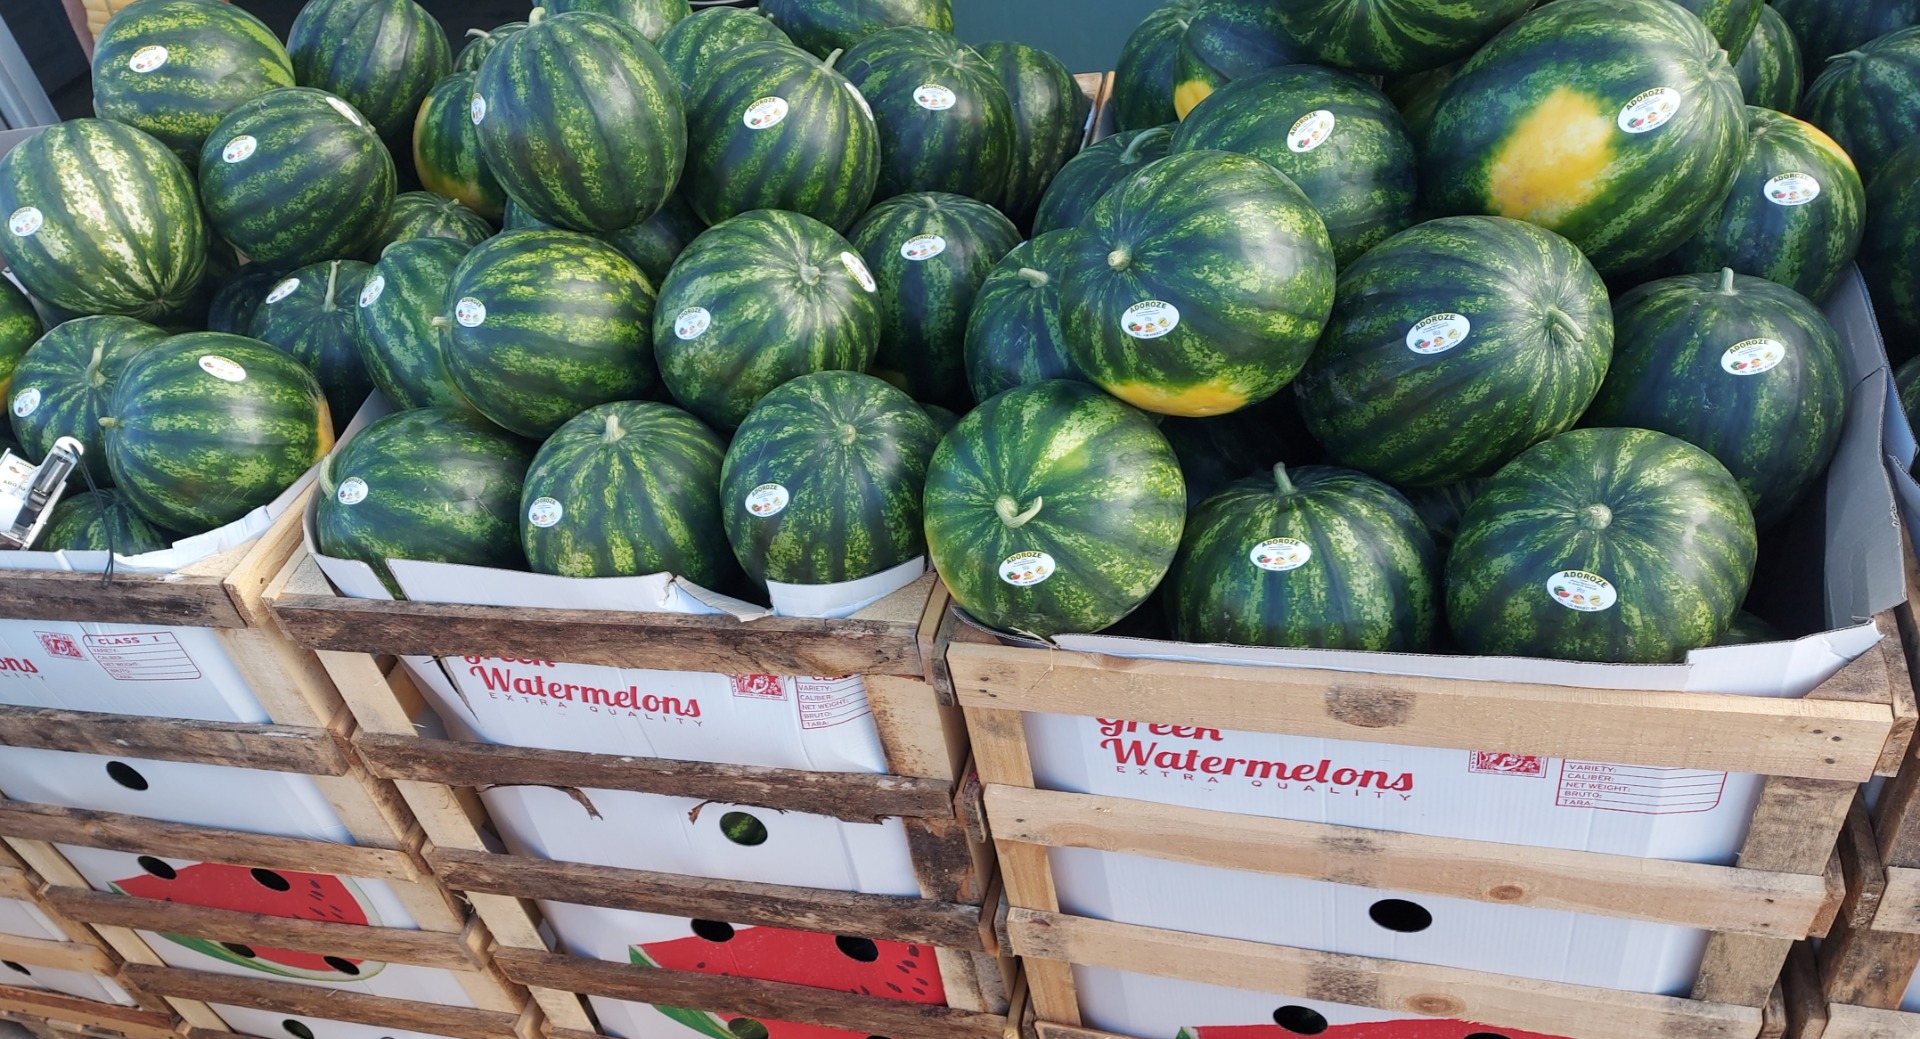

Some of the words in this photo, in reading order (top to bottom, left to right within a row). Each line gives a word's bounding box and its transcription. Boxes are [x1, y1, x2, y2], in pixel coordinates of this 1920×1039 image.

[748, 97, 776, 113] ADOROZE
[1626, 88, 1665, 111] ADOROZE
[1289, 112, 1318, 136] ADOROZE
[679, 307, 702, 321] ADOROZE
[1130, 301, 1167, 314] ADOROZE
[1415, 314, 1456, 331] ADOROZE
[1729, 339, 1769, 354] ADOROZE
[751, 484, 779, 498] ADOROZE
[1261, 538, 1301, 548] ADOROZE
[1006, 551, 1042, 564] ADOROZE
[1563, 571, 1608, 589] ADOROZE
[98, 637, 140, 645] CLASS
[469, 665, 701, 718] Watermelons
[488, 691, 568, 709] EXTRA
[589, 705, 703, 728] QUALITY
[818, 698, 850, 710] WEIGHT:
[803, 711, 833, 719] BRUTO:
[806, 720, 830, 728] TARA:
[1100, 738, 1414, 792] Watermelons
[1569, 764, 1617, 773] VARIETY:
[1117, 766, 1219, 784] EXTRA
[1251, 780, 1412, 802] QUALITY
[1567, 773, 1615, 782] CALIBER:
[1565, 781, 1587, 789] NET
[1588, 783, 1632, 793] WEIGHT:
[1564, 791, 1603, 799] BRUTO:
